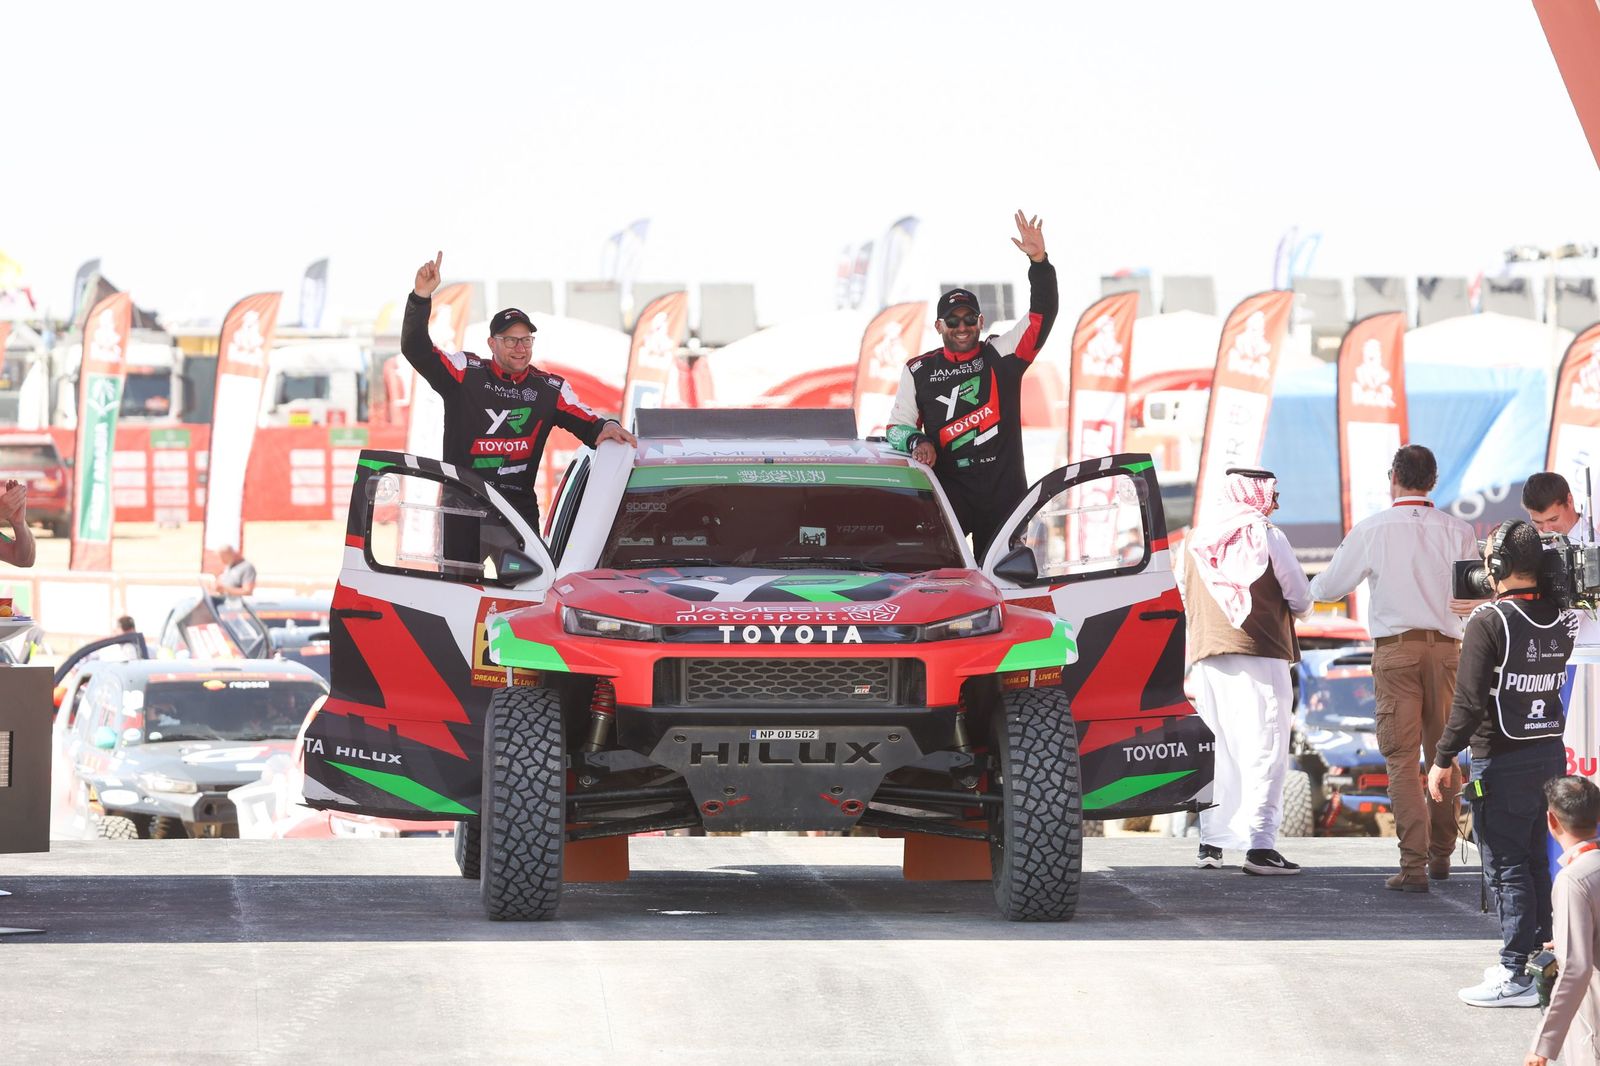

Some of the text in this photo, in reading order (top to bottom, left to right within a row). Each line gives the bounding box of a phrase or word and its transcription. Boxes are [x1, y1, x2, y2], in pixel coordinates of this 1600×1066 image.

[946, 407, 993, 436] TOYOTA
[477, 440, 529, 452] TOYOTA
[626, 502, 668, 512] sparco
[676, 605, 835, 614] JAMEEL
[676, 612, 836, 622] motorsport
[718, 625, 863, 644] TOYOTA
[1505, 672, 1557, 693] PODIUM
[760, 730, 775, 739] NP
[794, 730, 816, 739] 502
[336, 745, 402, 765] HILUX
[690, 742, 881, 766] HILUX
[1123, 741, 1188, 762] TOYOTA
